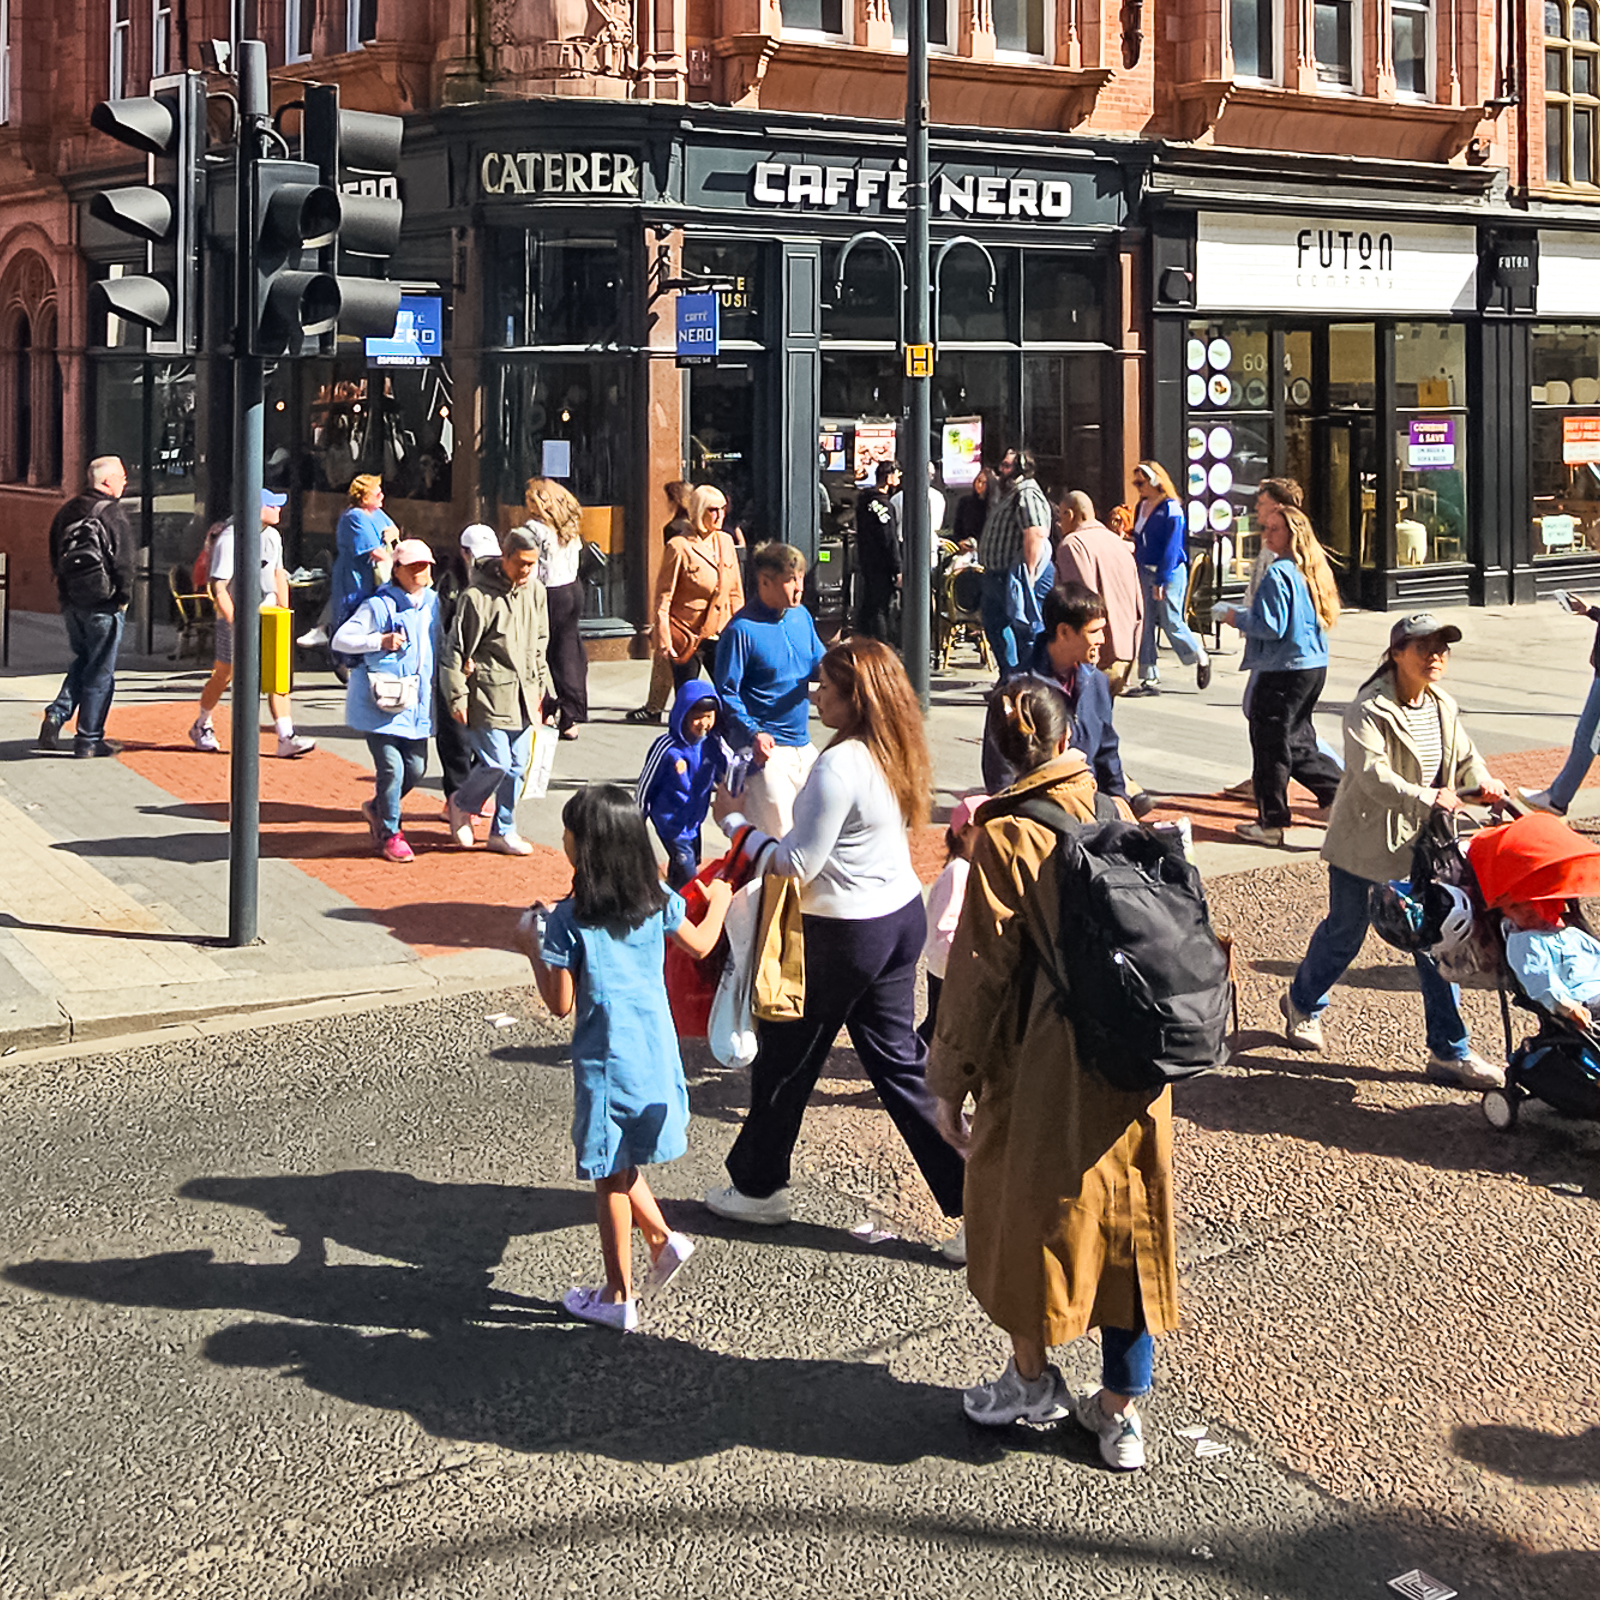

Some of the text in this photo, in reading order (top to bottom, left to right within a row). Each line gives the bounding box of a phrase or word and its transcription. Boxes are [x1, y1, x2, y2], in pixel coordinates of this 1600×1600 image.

[481, 152, 639, 196] CATERER
[338, 176, 398, 200] ERO
[753, 158, 1072, 218] CAFFÈ NERO
[1296, 229, 1394, 271] FUTON
[1498, 255, 1529, 271] FUTON
[394, 328, 435, 345] ERO
[678, 328, 713, 343] NERO
